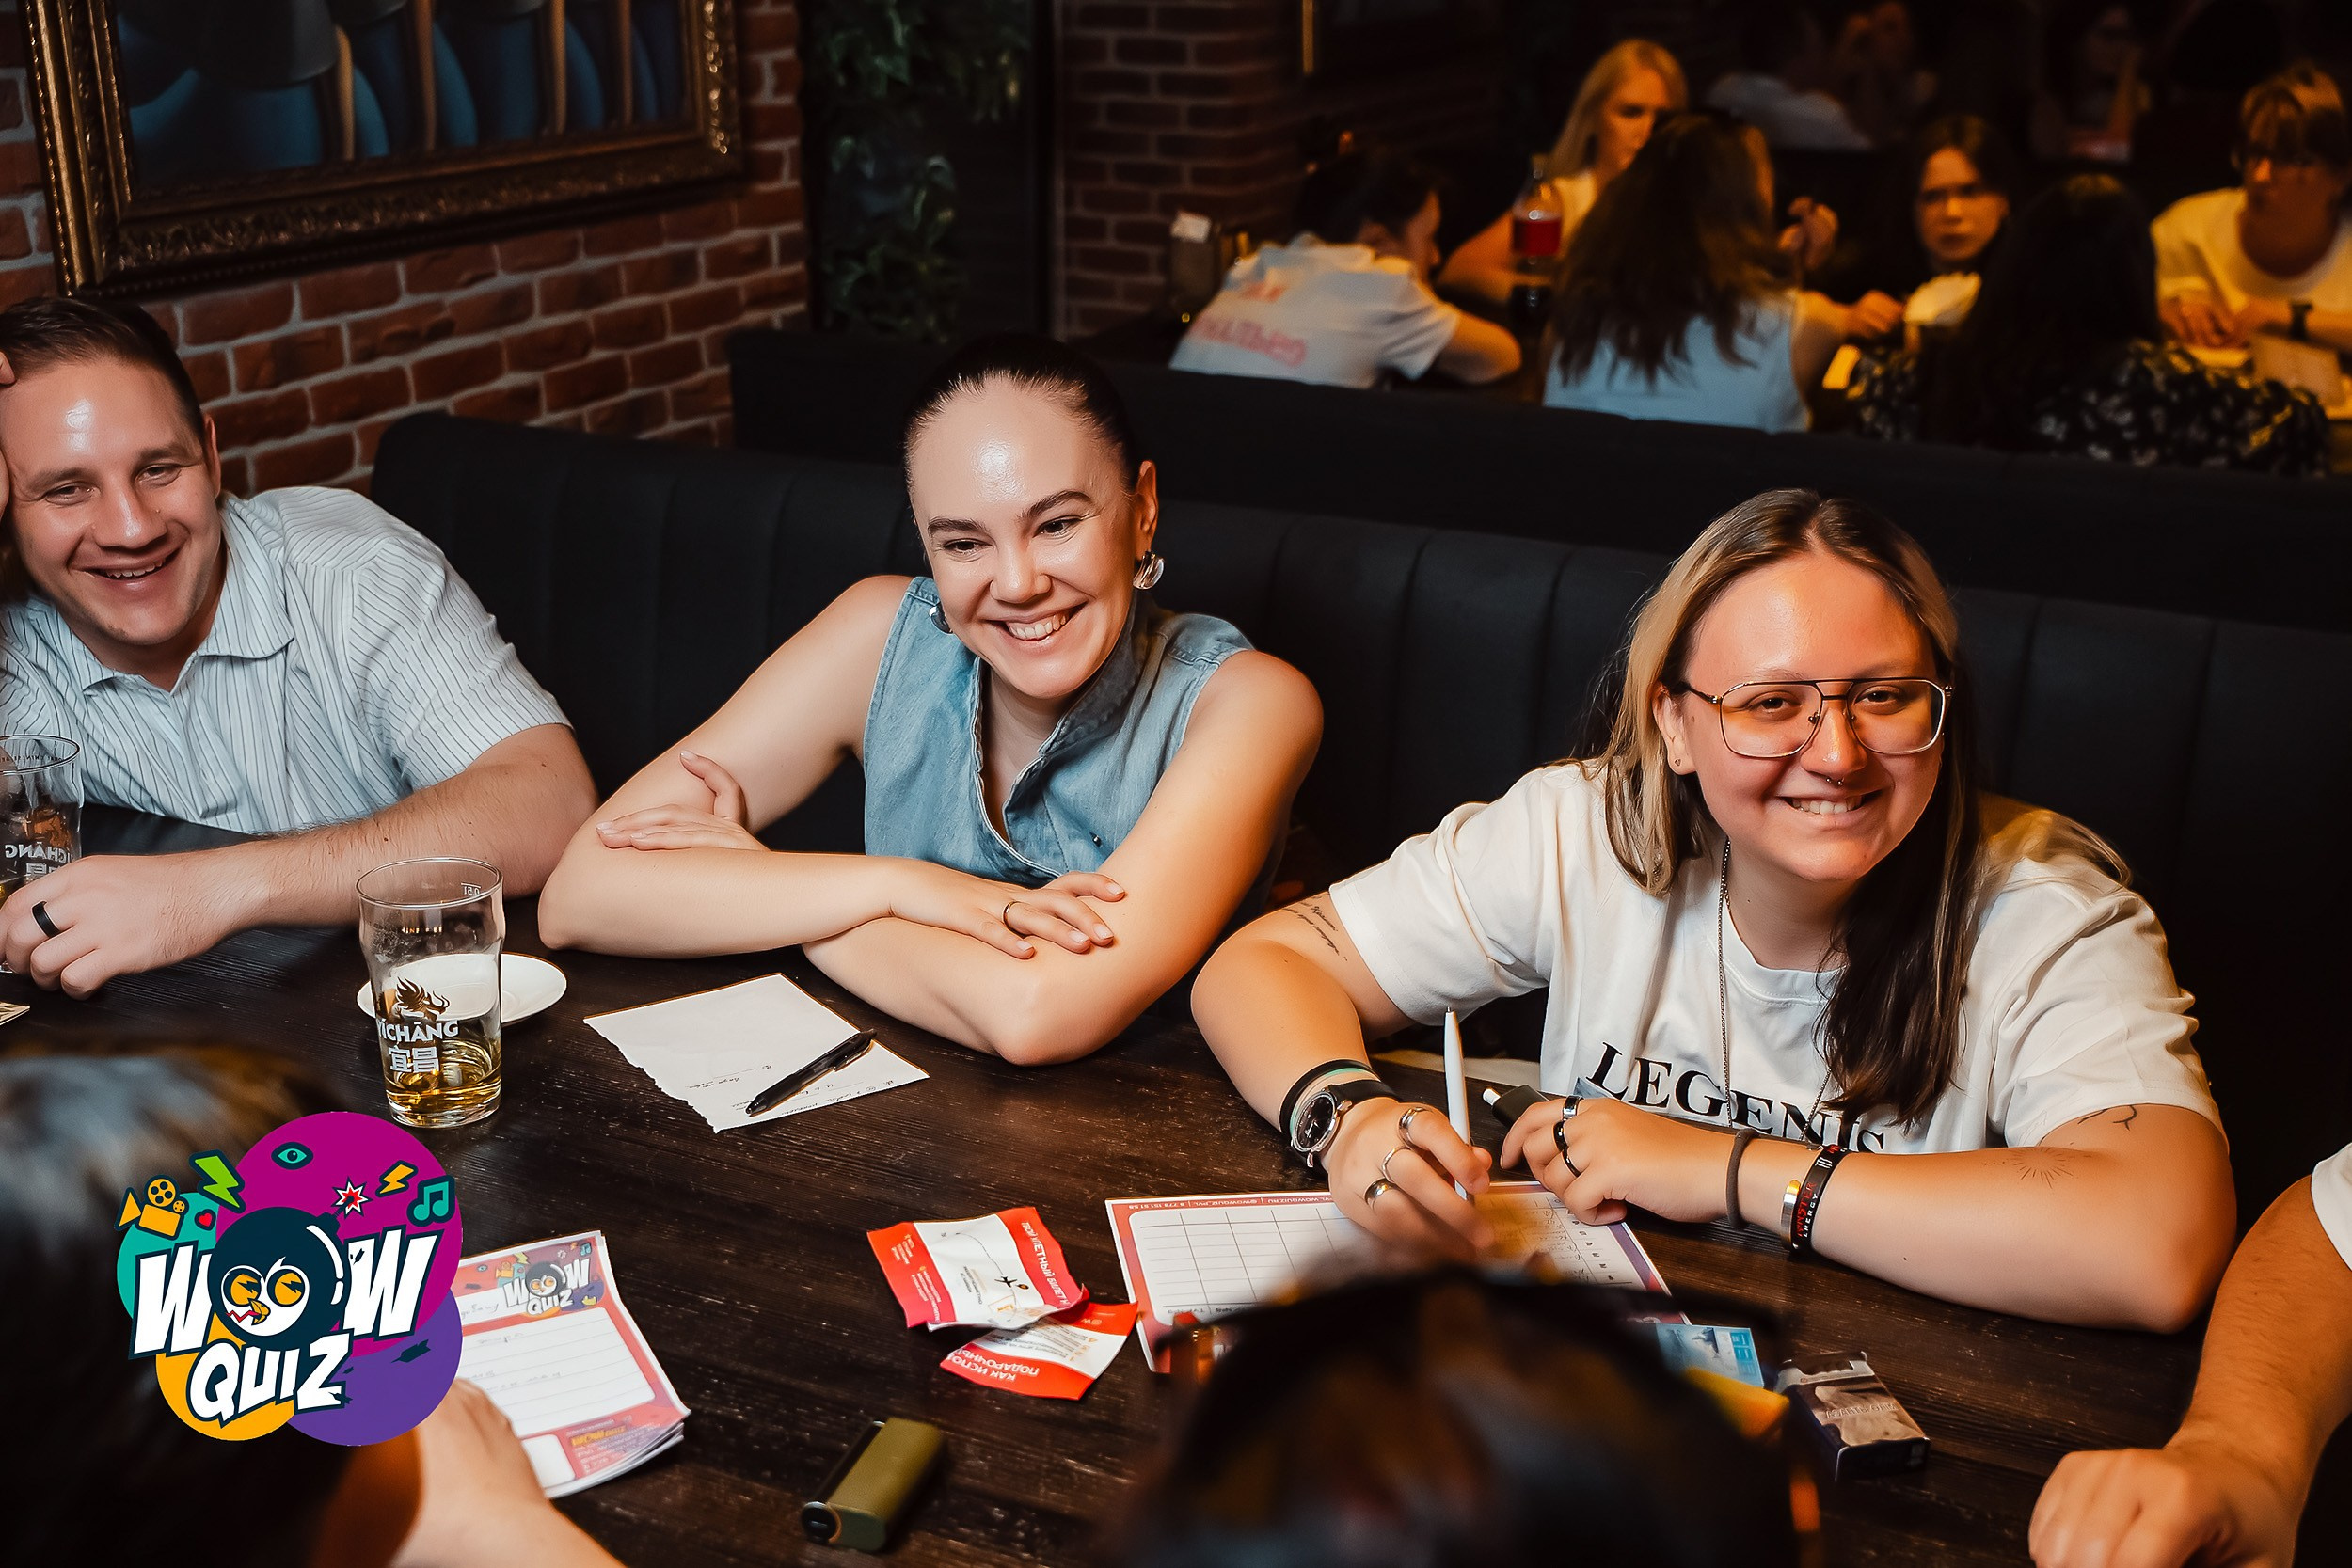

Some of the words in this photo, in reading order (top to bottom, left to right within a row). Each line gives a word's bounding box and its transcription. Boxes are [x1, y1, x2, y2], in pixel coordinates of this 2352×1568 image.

[388, 1045, 439, 1073] 宜昌
[1803, 1193, 1819, 1238] ENERGY
[503, 1258, 591, 1308] WOW
[1046, 1277, 1068, 1300] БИЛЕТ
[527, 1288, 574, 1315] QUIZ
[957, 1348, 1040, 1377] ПОДАРОЧНЫ
[989, 1370, 1017, 1382] КАК
